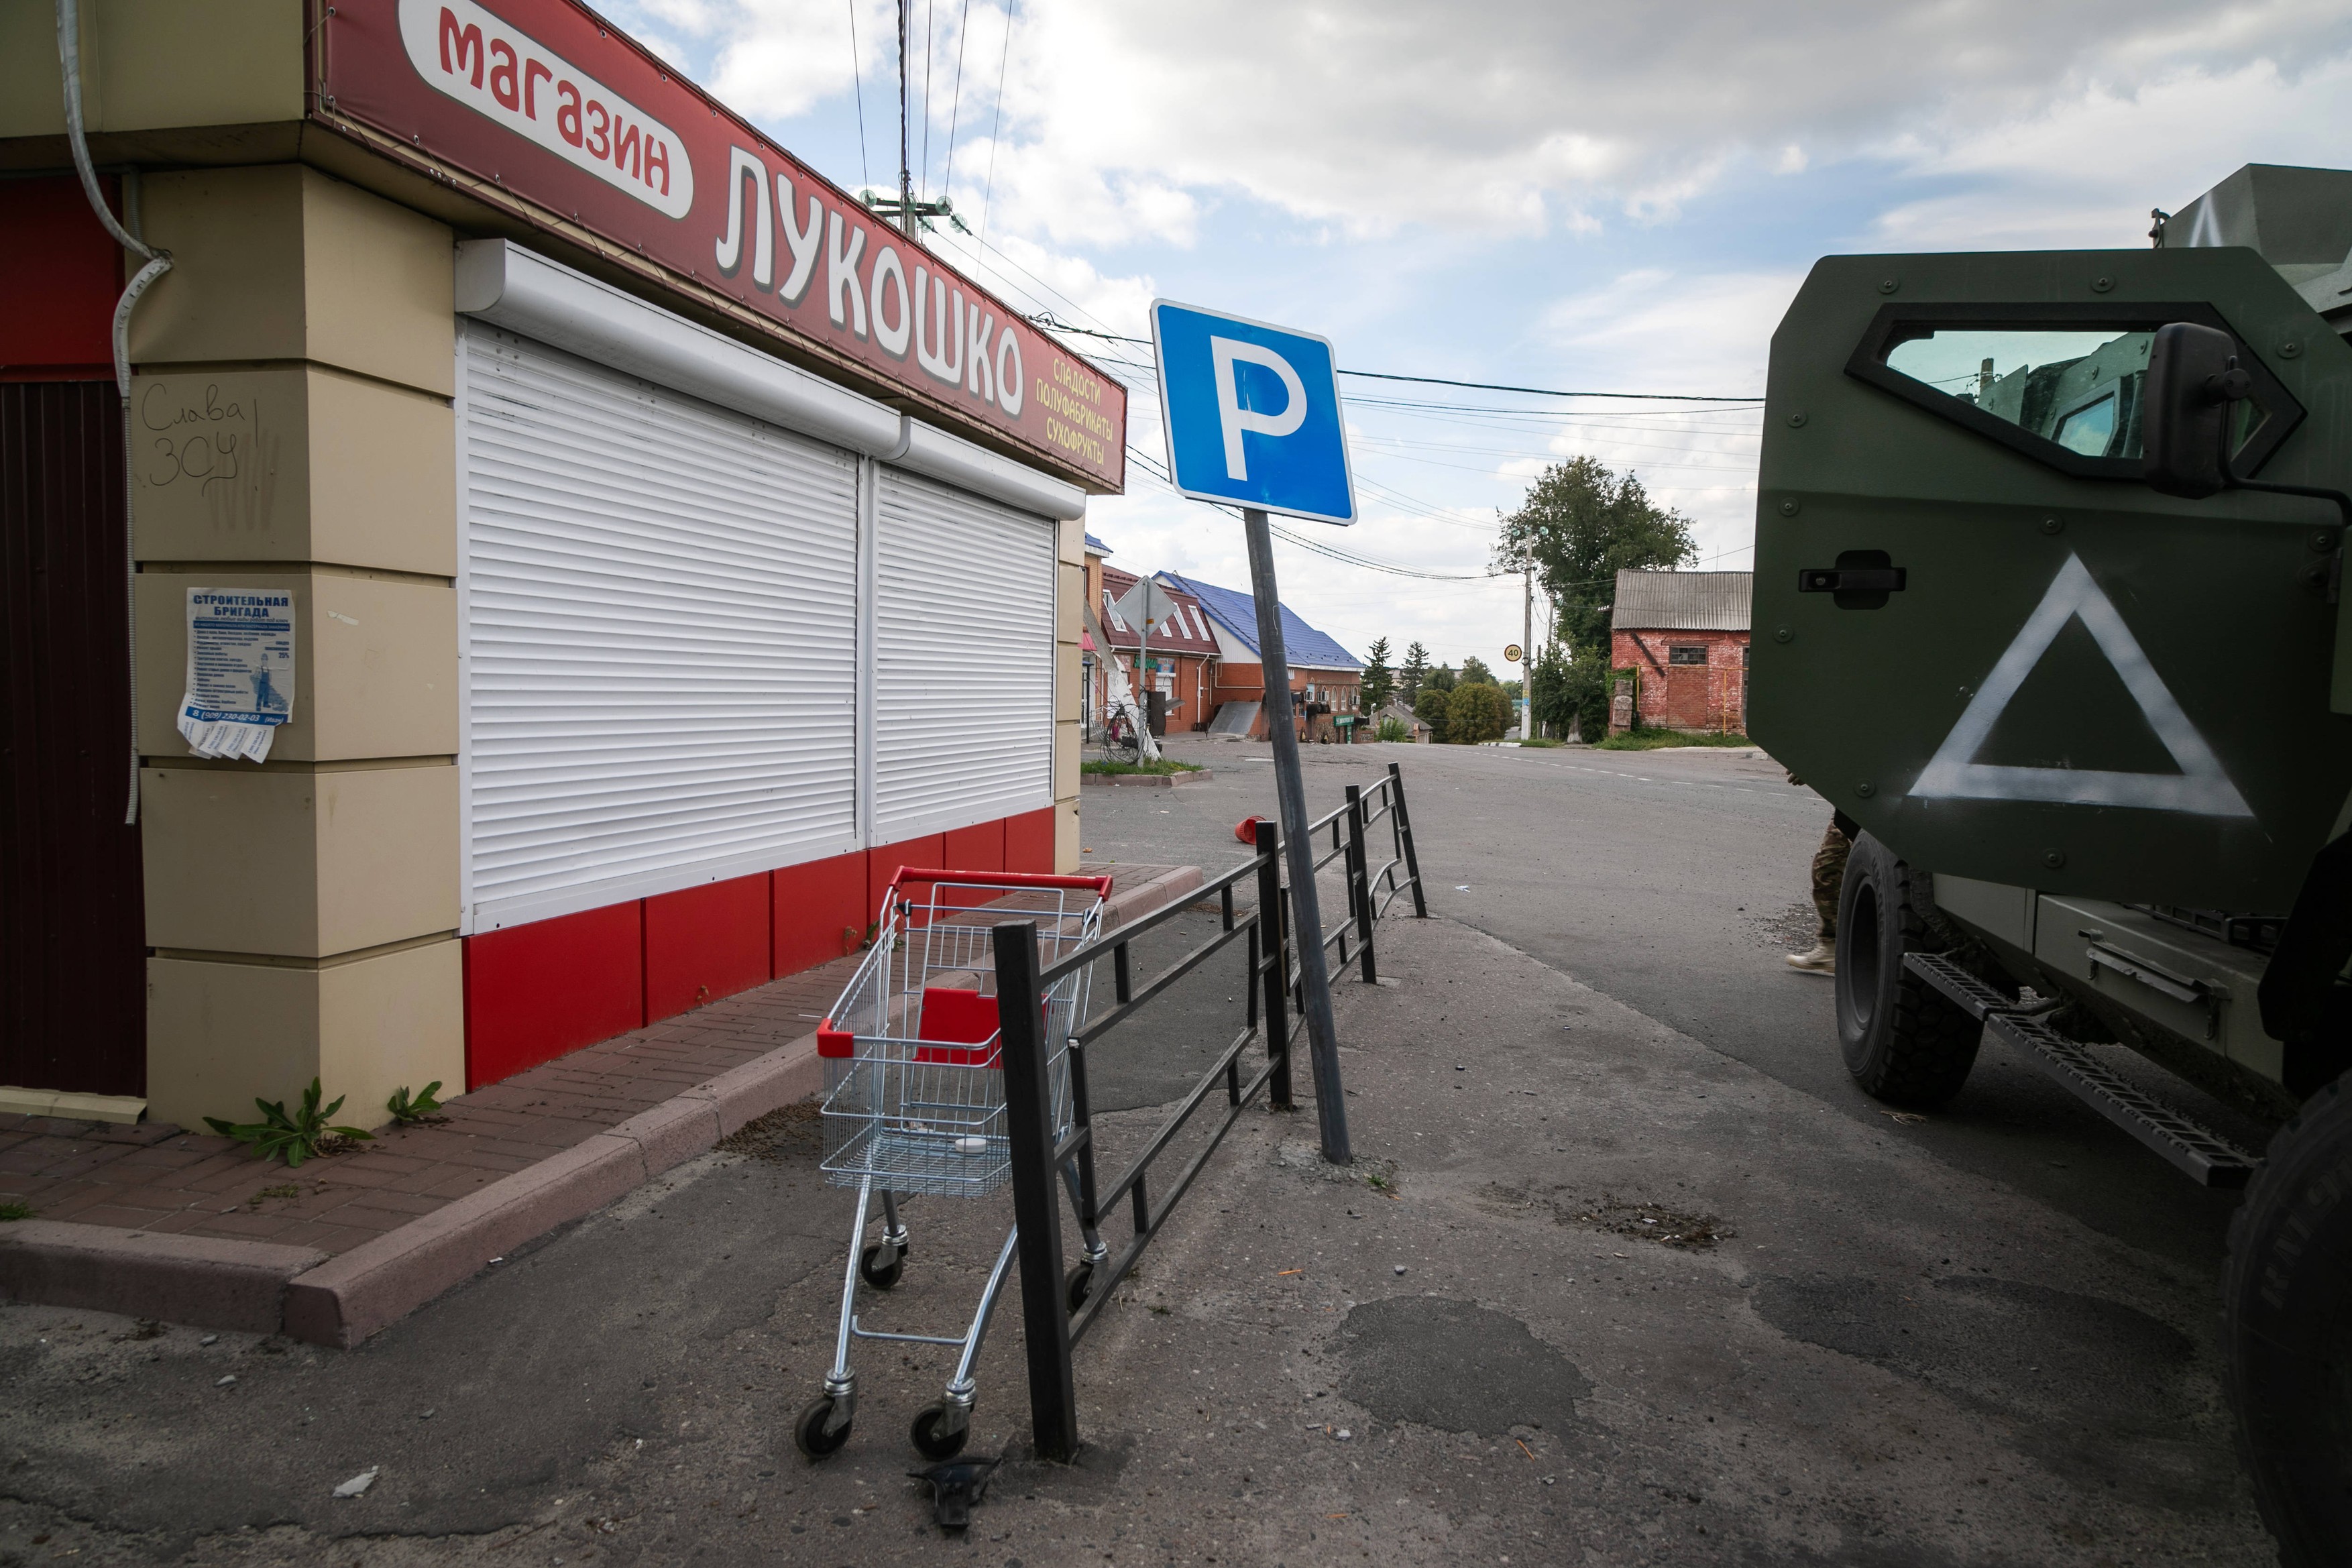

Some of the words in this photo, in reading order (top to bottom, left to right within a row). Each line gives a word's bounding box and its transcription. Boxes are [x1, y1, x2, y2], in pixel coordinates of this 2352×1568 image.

[439, 6, 669, 197] магазин
[716, 144, 1024, 420] ЛУКОШКО
[1054, 358, 1101, 406] СЛАДОСТИ
[142, 383, 245, 431] Слава
[1036, 378, 1113, 443] ПОЛУФАБРИКАТЫ
[1210, 335, 1307, 482] P
[1046, 416, 1104, 465] СУХОФРУКТЫ
[193, 595, 288, 607] СТРОИТЕЛЬНАЯ
[214, 606, 270, 618] БРИГАДА
[201, 711, 221, 720] (909)
[222, 712, 260, 721] 230-02-03
